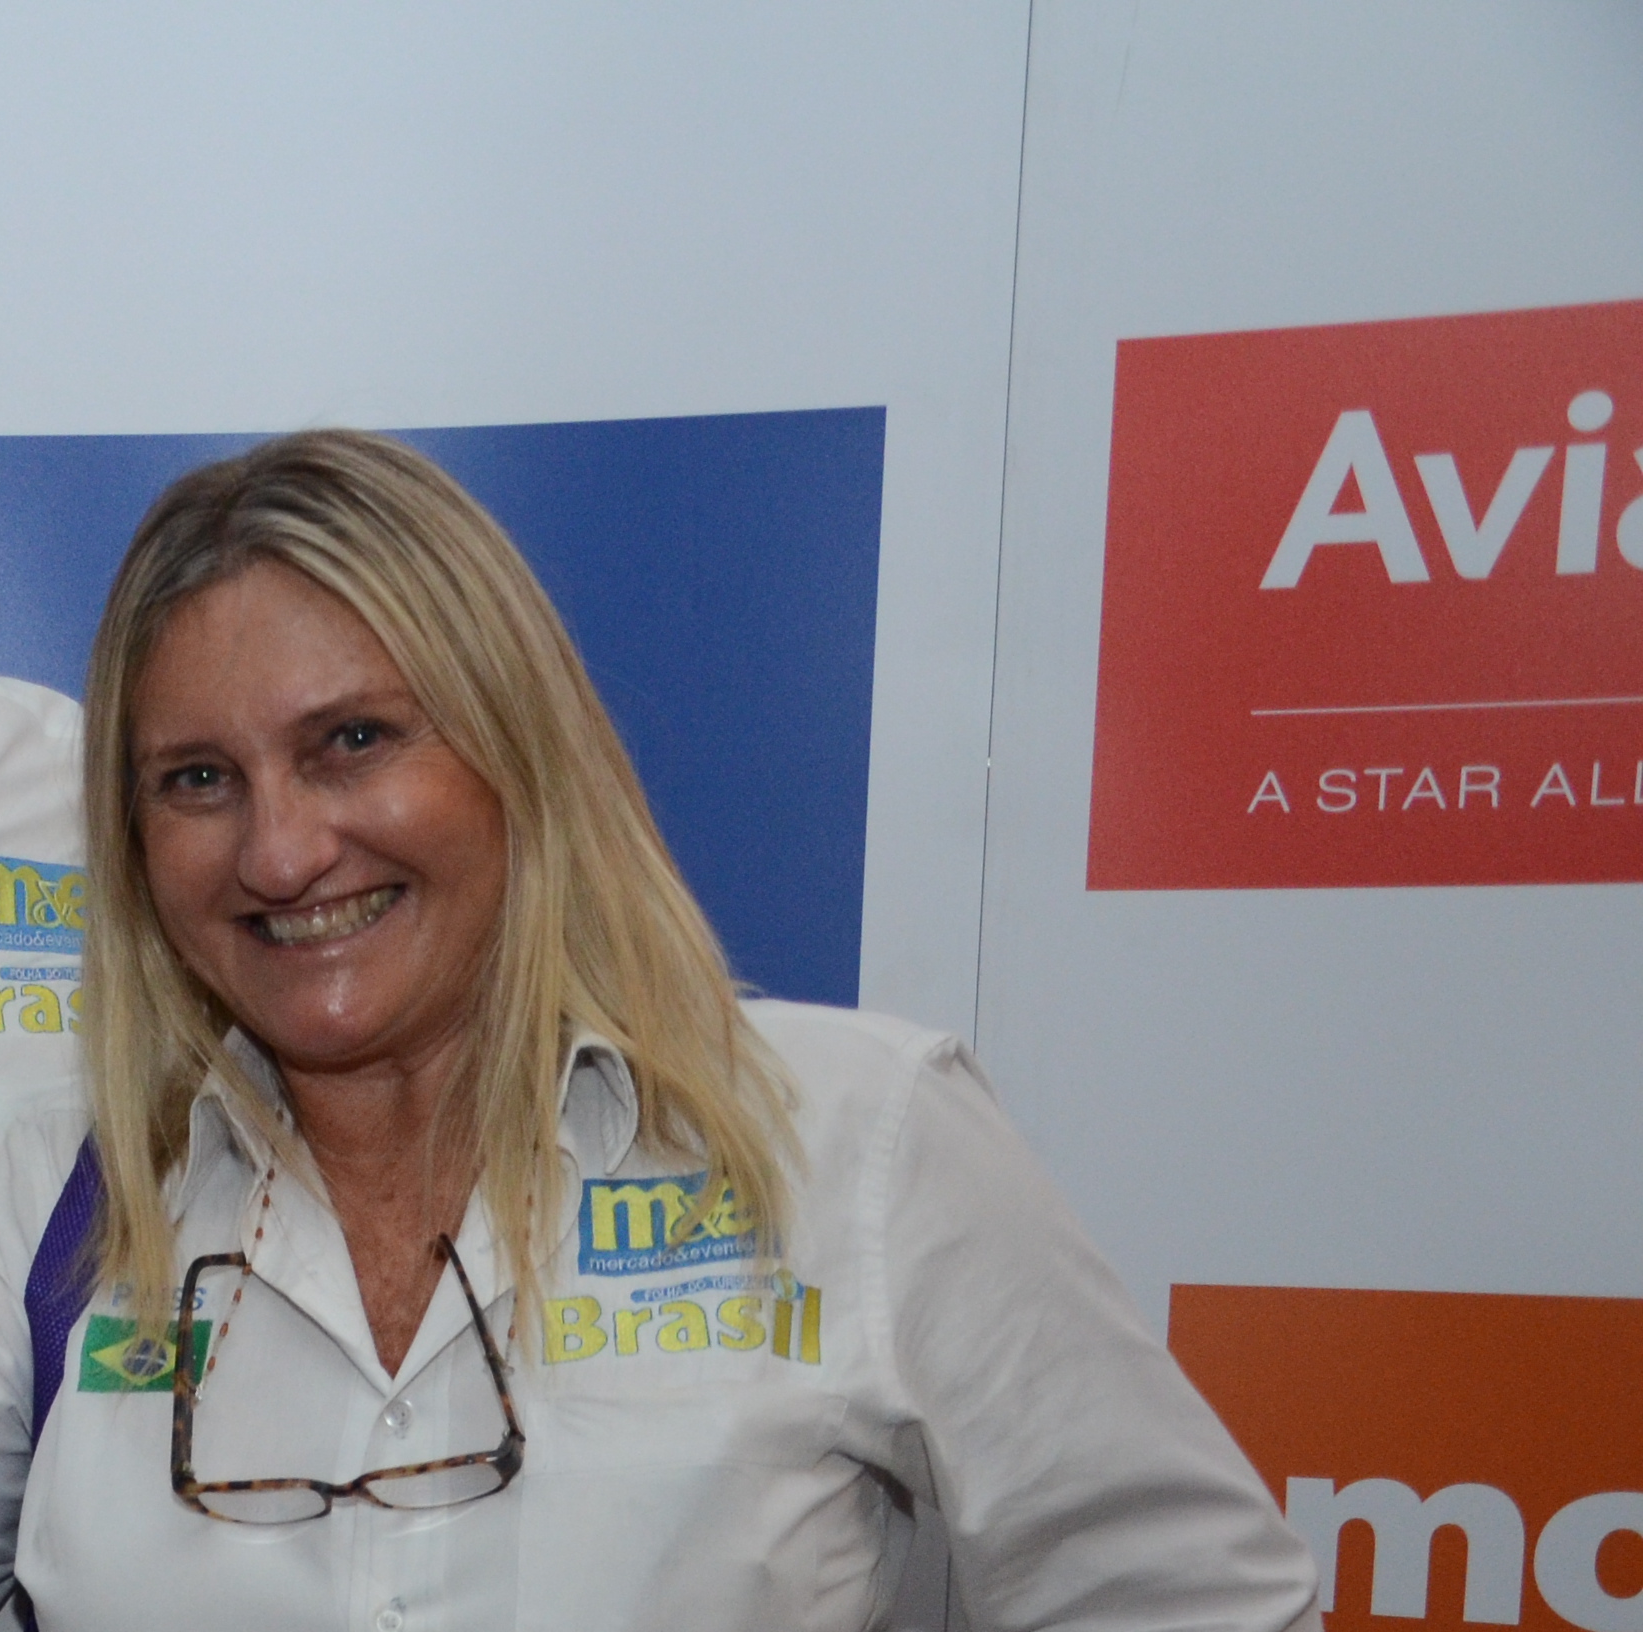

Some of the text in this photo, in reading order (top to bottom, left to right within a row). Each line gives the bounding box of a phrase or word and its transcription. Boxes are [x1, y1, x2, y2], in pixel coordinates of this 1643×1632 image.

[1258, 390, 1643, 590] Avi
[1247, 760, 1643, 813] A STAR AL
[543, 1270, 821, 1365] Brasil
